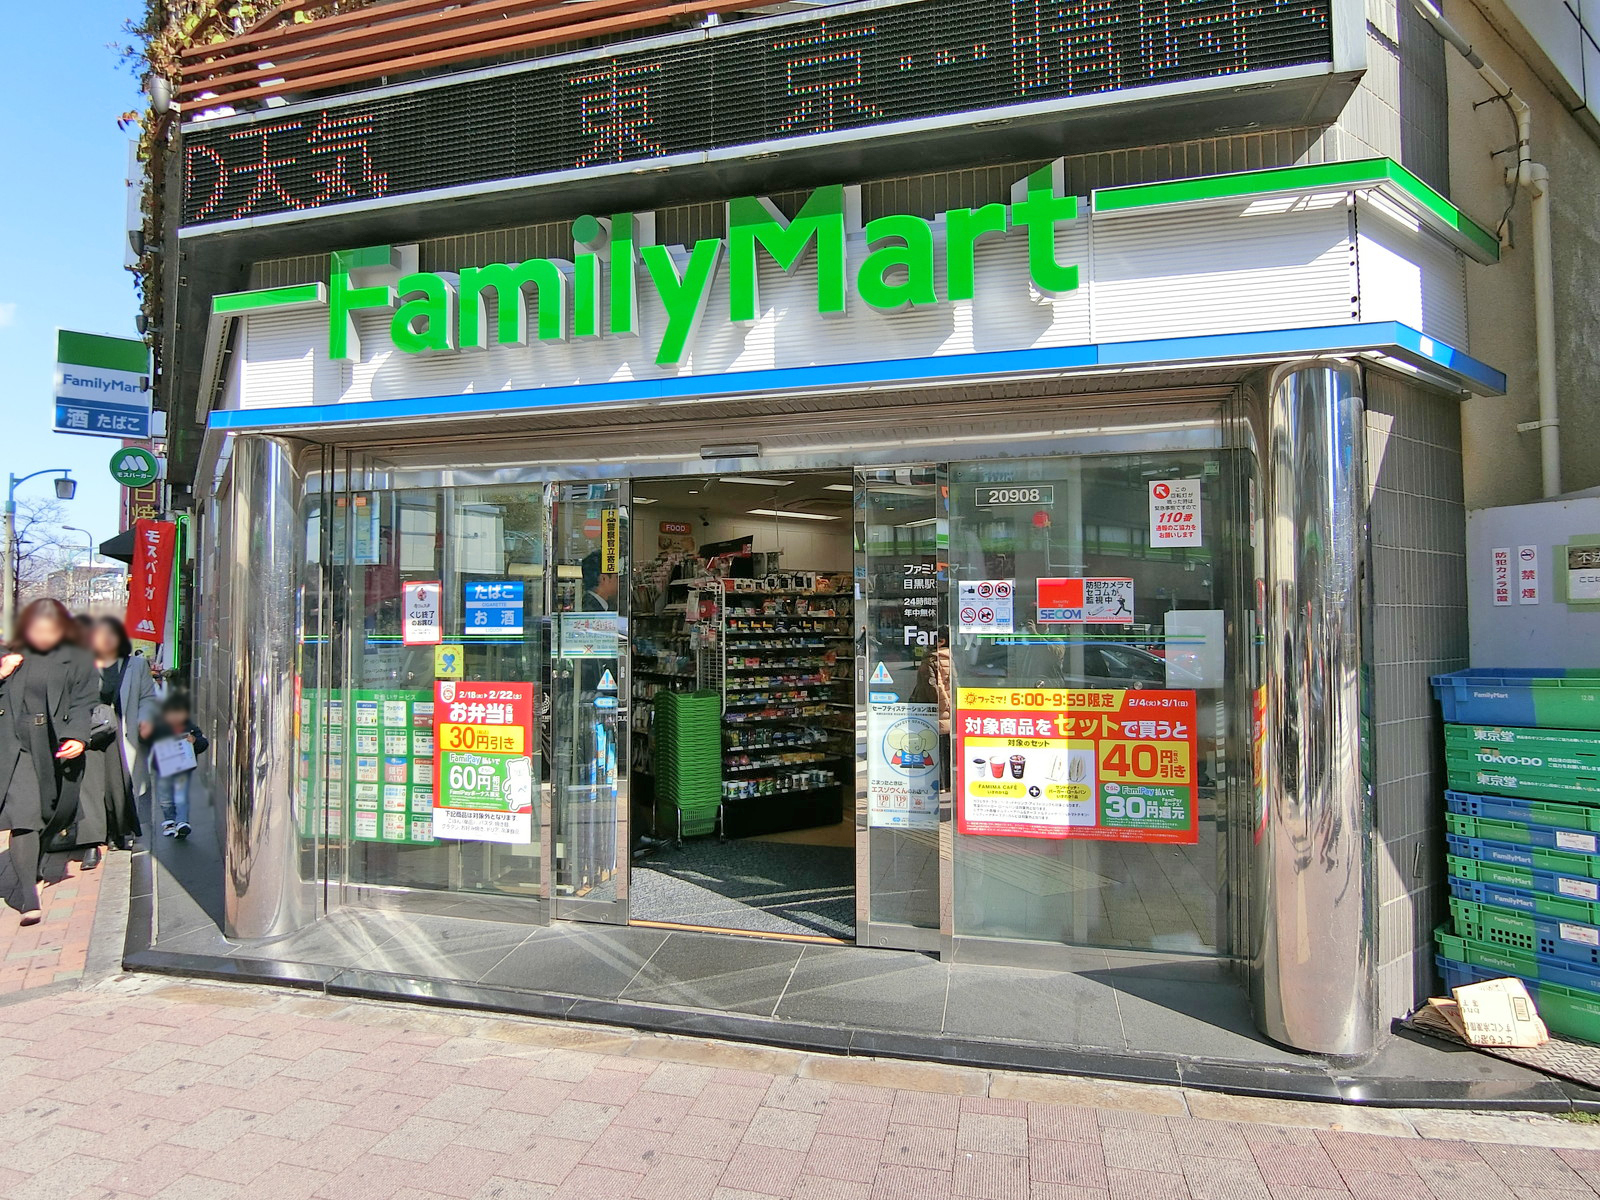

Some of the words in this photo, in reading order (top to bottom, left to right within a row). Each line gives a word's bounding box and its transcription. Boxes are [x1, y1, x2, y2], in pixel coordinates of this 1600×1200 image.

[328, 160, 1080, 368] FamilyMart
[66, 408, 89, 429] 酒
[97, 413, 140, 431] たばこ
[116, 471, 153, 479] モスバーガー
[988, 488, 1040, 503] 20908
[1159, 511, 1194, 523] 110番
[665, 524, 686, 532] FOOD
[1158, 531, 1194, 539] お願いします
[1495, 551, 1509, 602] 防犯カメラ設置
[903, 578, 938, 590] 目黒駅
[1085, 581, 1132, 590] 防犯カメラで
[1521, 569, 1536, 599] 禁煙
[474, 584, 514, 600] たばこ
[1086, 588, 1119, 597] セコムが
[1085, 596, 1113, 605] 監視中
[409, 610, 435, 619] くじ終了
[903, 609, 937, 618] 年中無休
[1040, 609, 1082, 619] SECOM
[1473, 691, 1509, 699] FamilyMart
[449, 701, 505, 724] お弁当
[871, 705, 938, 713] セーフティステーション活動
[964, 713, 1188, 739] 対象商品をセットで買うと
[449, 726, 515, 750] 30円引き
[1473, 730, 1515, 742] 東京堂
[1008, 739, 1050, 748] 対象のセット
[449, 753, 481, 765] FamiPay
[1474, 753, 1543, 767] TOKYO-DO
[449, 765, 491, 790] 60円
[1476, 775, 1518, 788] 東京堂
[1121, 785, 1155, 797] FamiPay
[1492, 851, 1532, 864] FamilyMart
[1493, 873, 1532, 886] FamilyMart
[1494, 895, 1534, 908] FamilyMart
[1494, 916, 1525, 927] FamilyMart
[1480, 955, 1516, 969] FamilyMart
